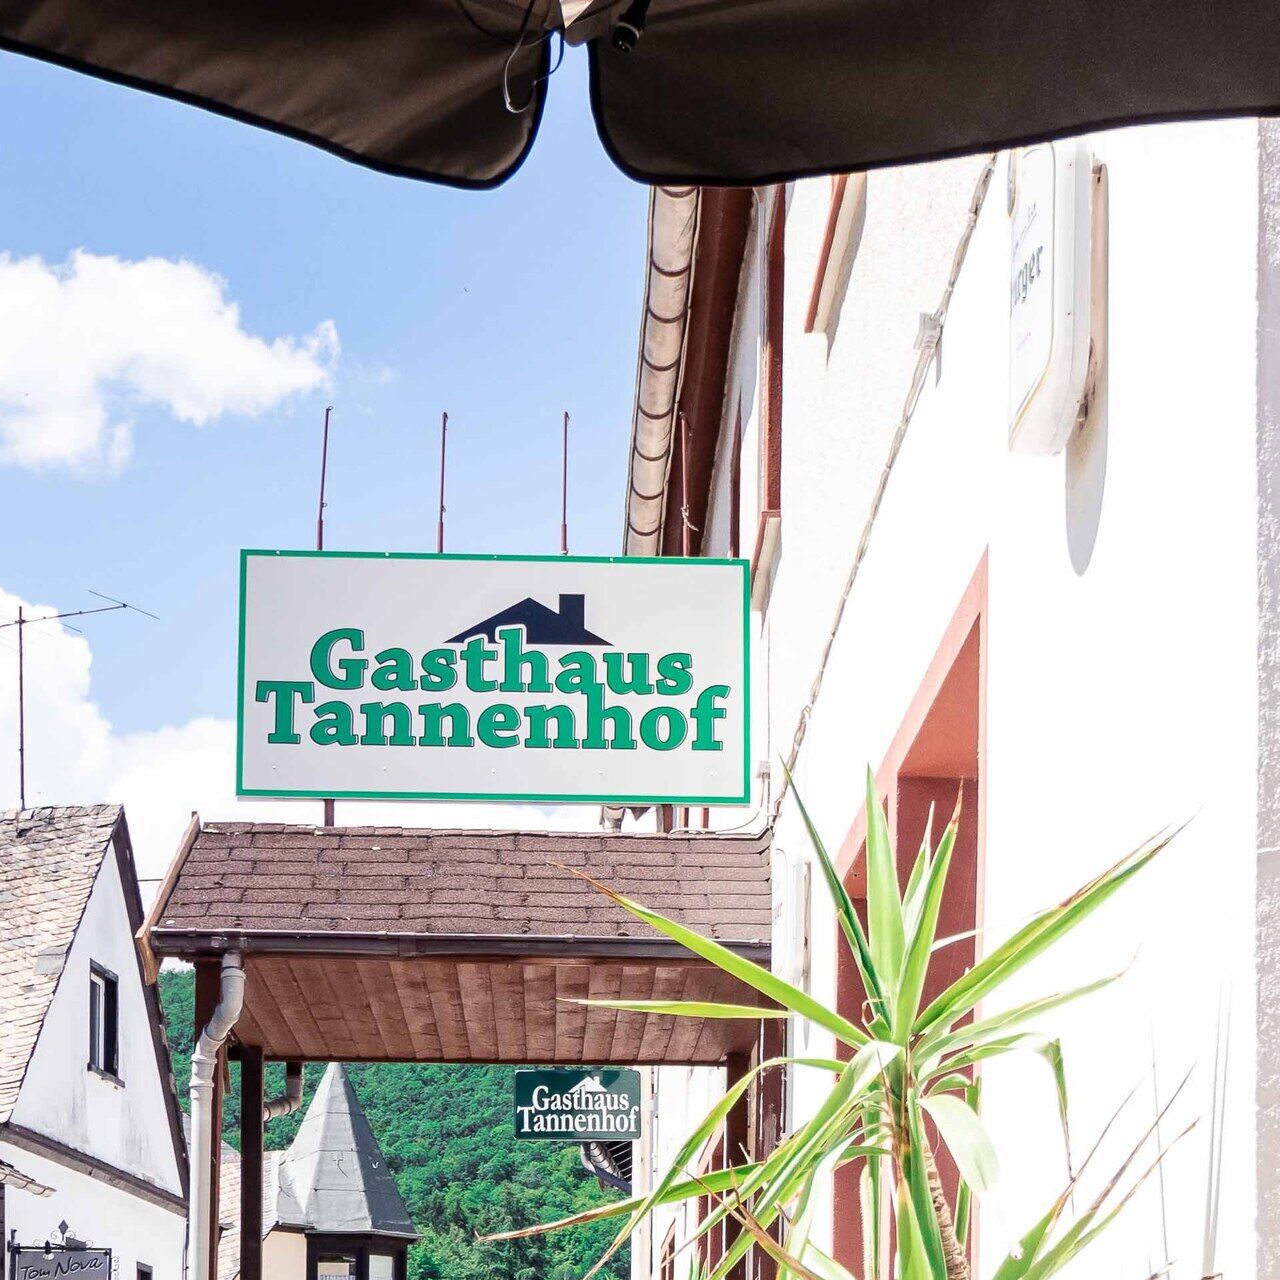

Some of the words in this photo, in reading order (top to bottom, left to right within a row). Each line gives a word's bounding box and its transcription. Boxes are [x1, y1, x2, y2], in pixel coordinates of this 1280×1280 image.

[310, 625, 694, 696] Gasthaus
[255, 681, 732, 752] Tannenhof
[532, 1085, 629, 1111] Gasthaus
[517, 1106, 640, 1132] Tannenhof
[21, 1264, 51, 1280] Tom
[55, 1256, 104, 1279] Nova
